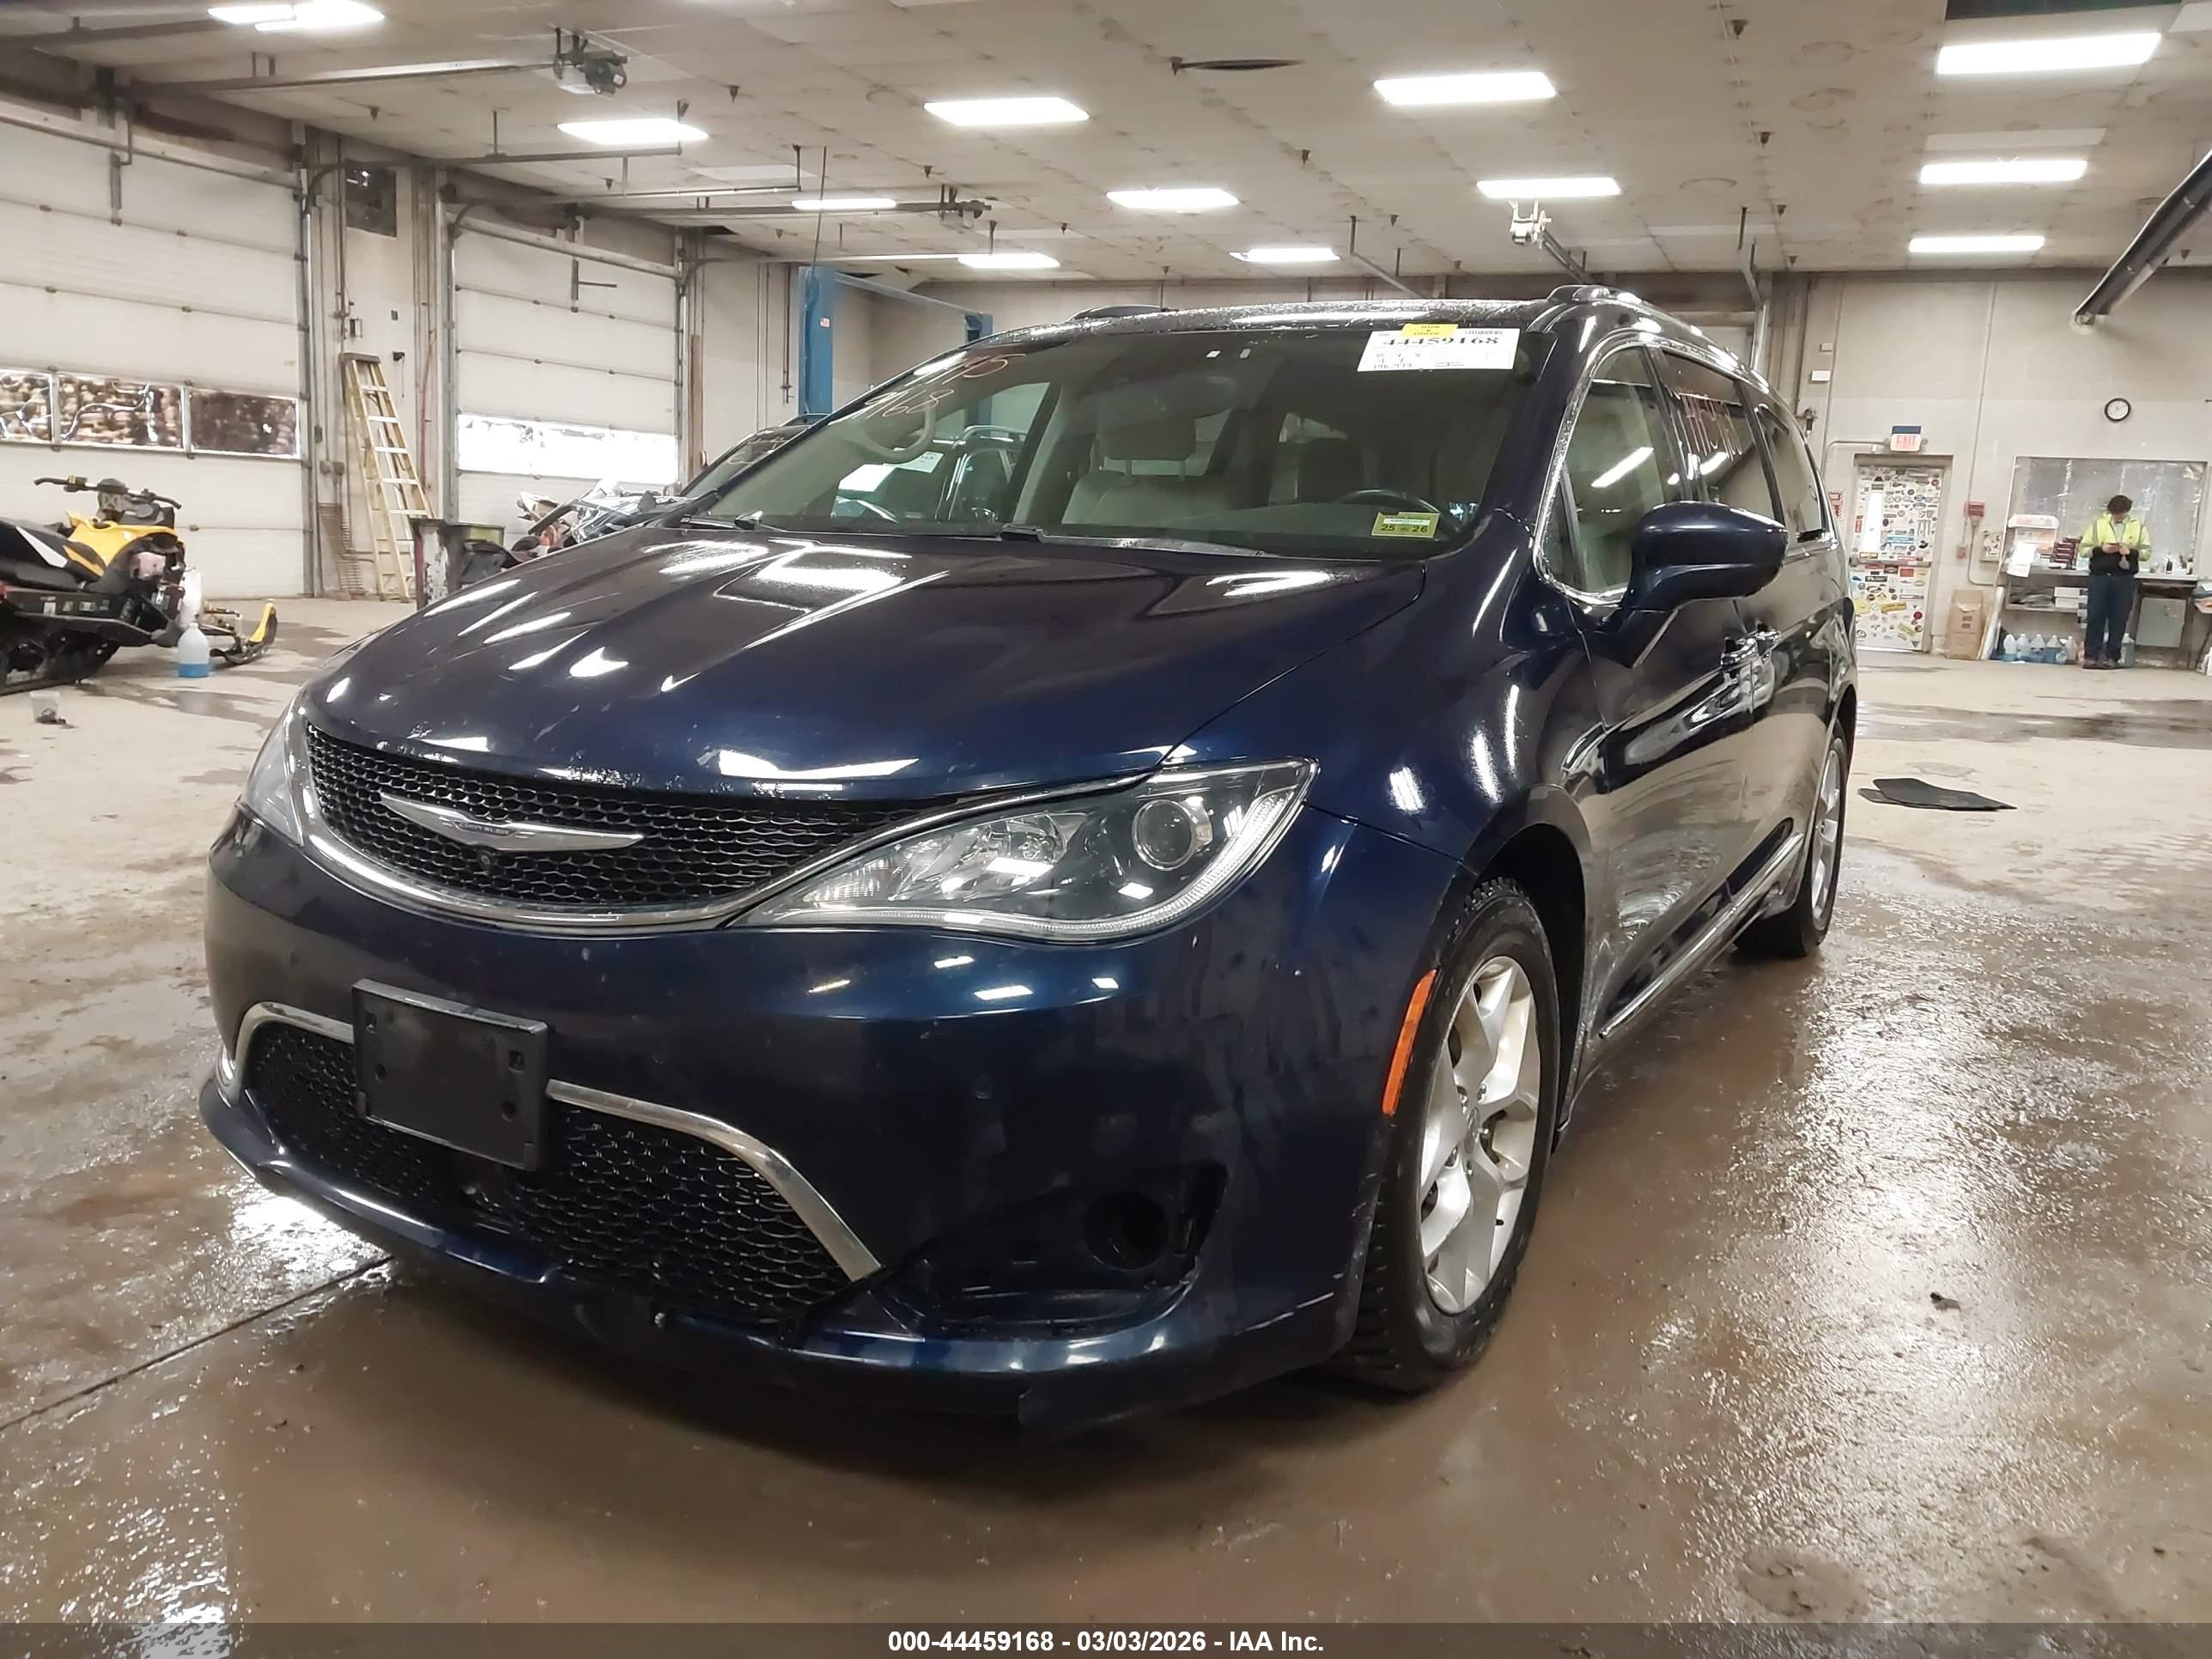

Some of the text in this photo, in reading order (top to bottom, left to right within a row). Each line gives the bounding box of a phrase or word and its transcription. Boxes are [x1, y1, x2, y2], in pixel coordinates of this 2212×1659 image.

[1382, 337, 1498, 345] 44459168
[851, 389, 955, 420] 9168
[1896, 434, 1917, 447] EXIT
[459, 822, 509, 835] CHRYSLER
